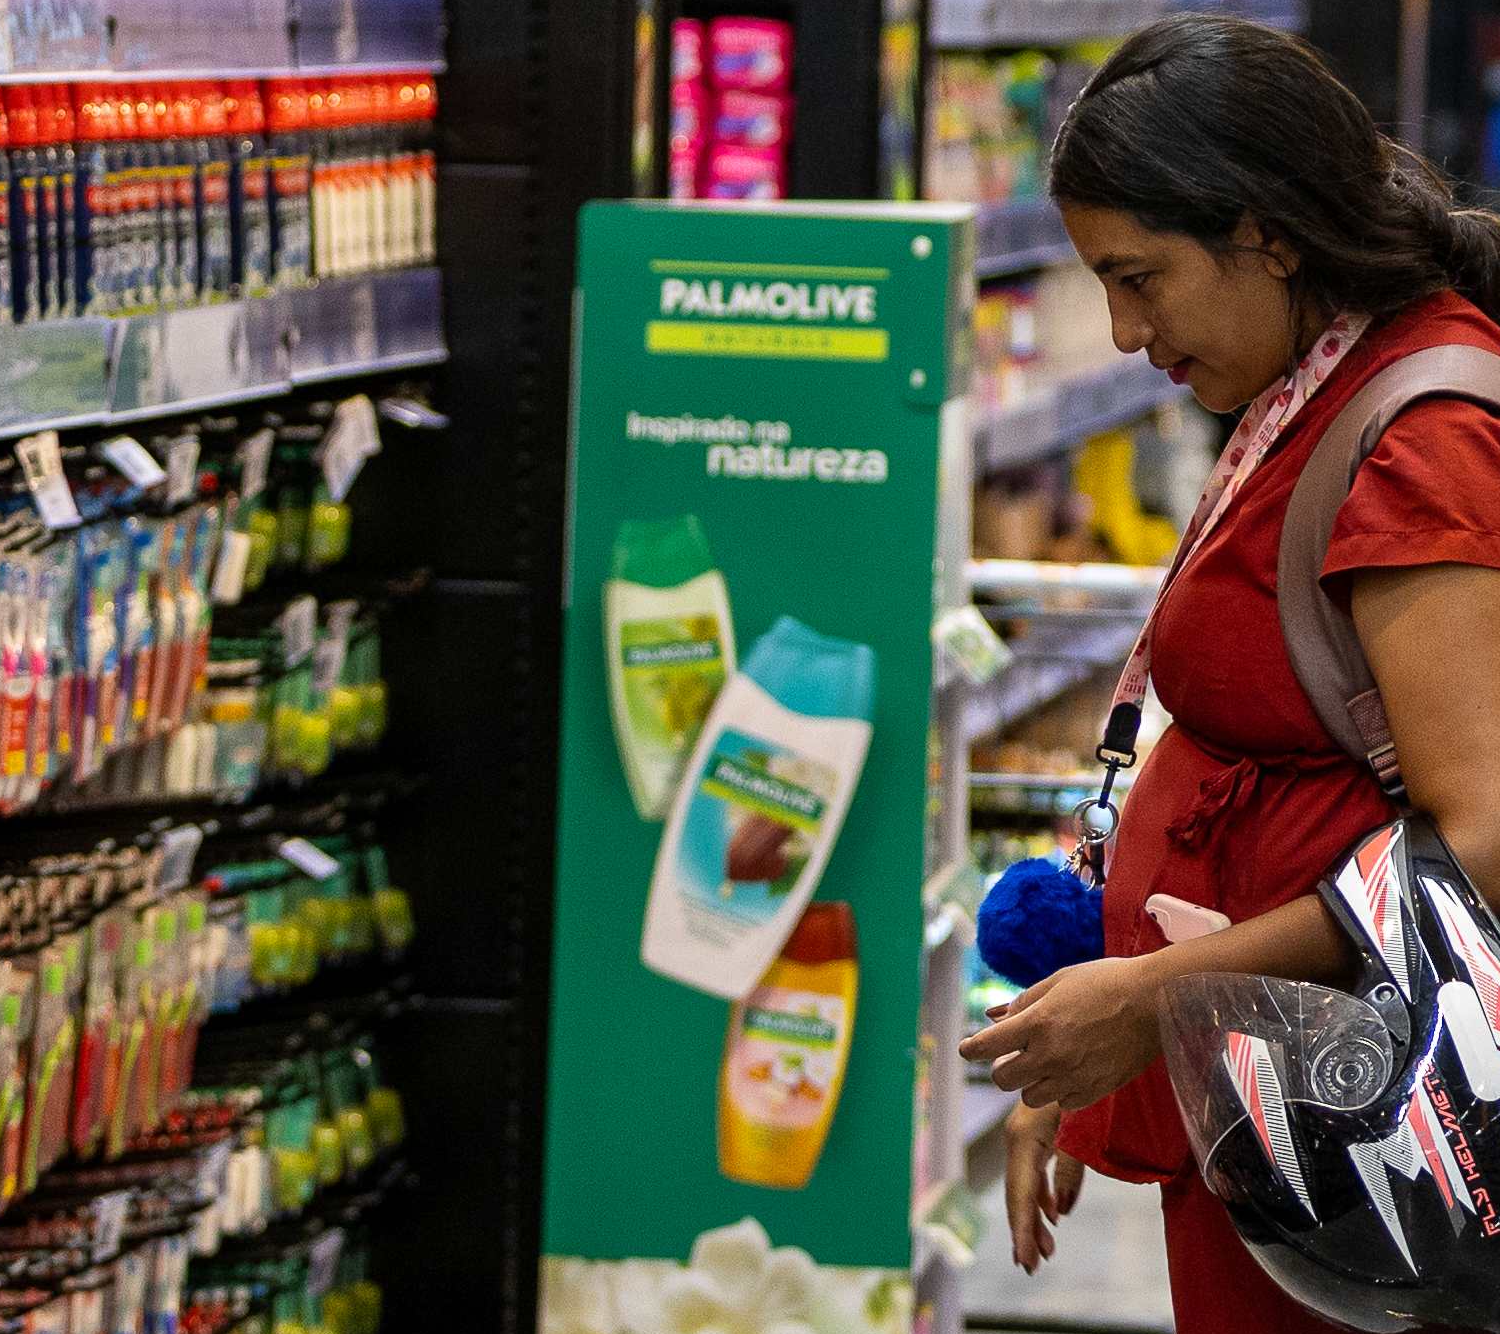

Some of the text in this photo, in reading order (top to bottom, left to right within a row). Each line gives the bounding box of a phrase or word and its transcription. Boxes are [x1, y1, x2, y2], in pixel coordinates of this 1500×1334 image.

[661, 279, 878, 323] PALMOLIVE
[626, 410, 791, 447] Inspirado na
[706, 441, 888, 484] natureza
[712, 760, 820, 818] PALMOLIVE
